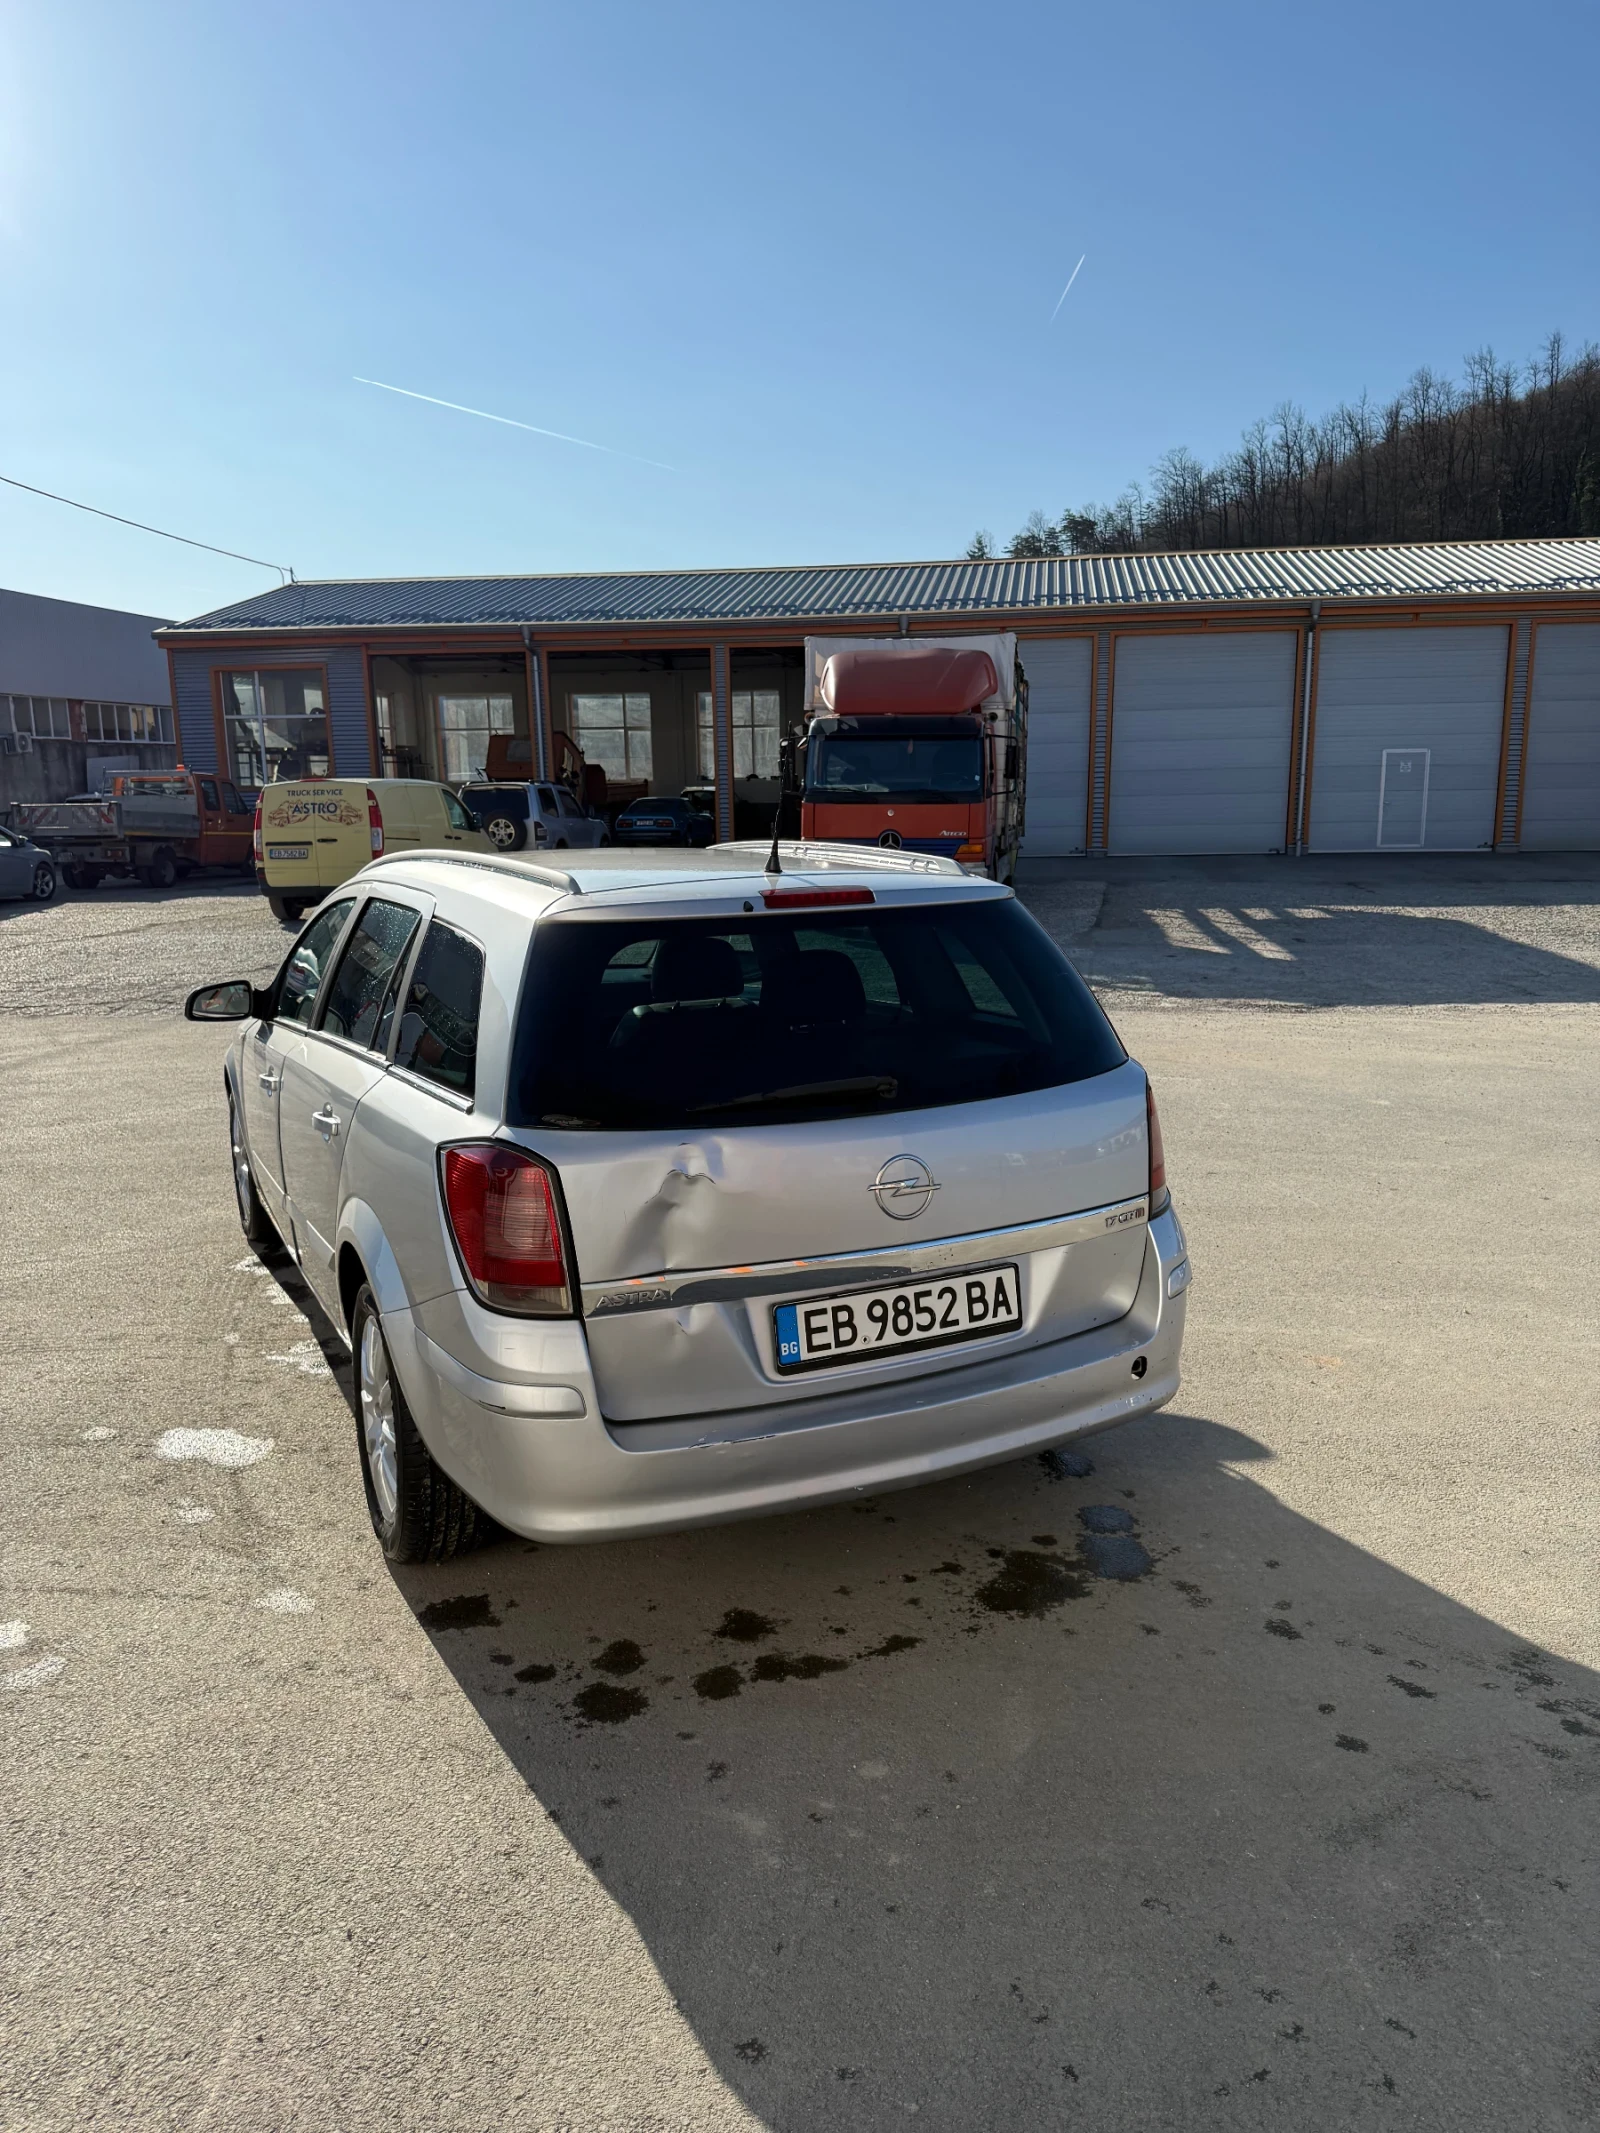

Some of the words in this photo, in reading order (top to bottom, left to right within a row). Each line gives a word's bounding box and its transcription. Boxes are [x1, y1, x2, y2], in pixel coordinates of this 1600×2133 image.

[292, 802, 338, 814] ASTRO
[596, 1288, 668, 1308] ASTRA
[804, 1304, 858, 1353] EB
[866, 1286, 960, 1342] 9852
[965, 1276, 1013, 1324] BA
[781, 1341, 798, 1356] BG
